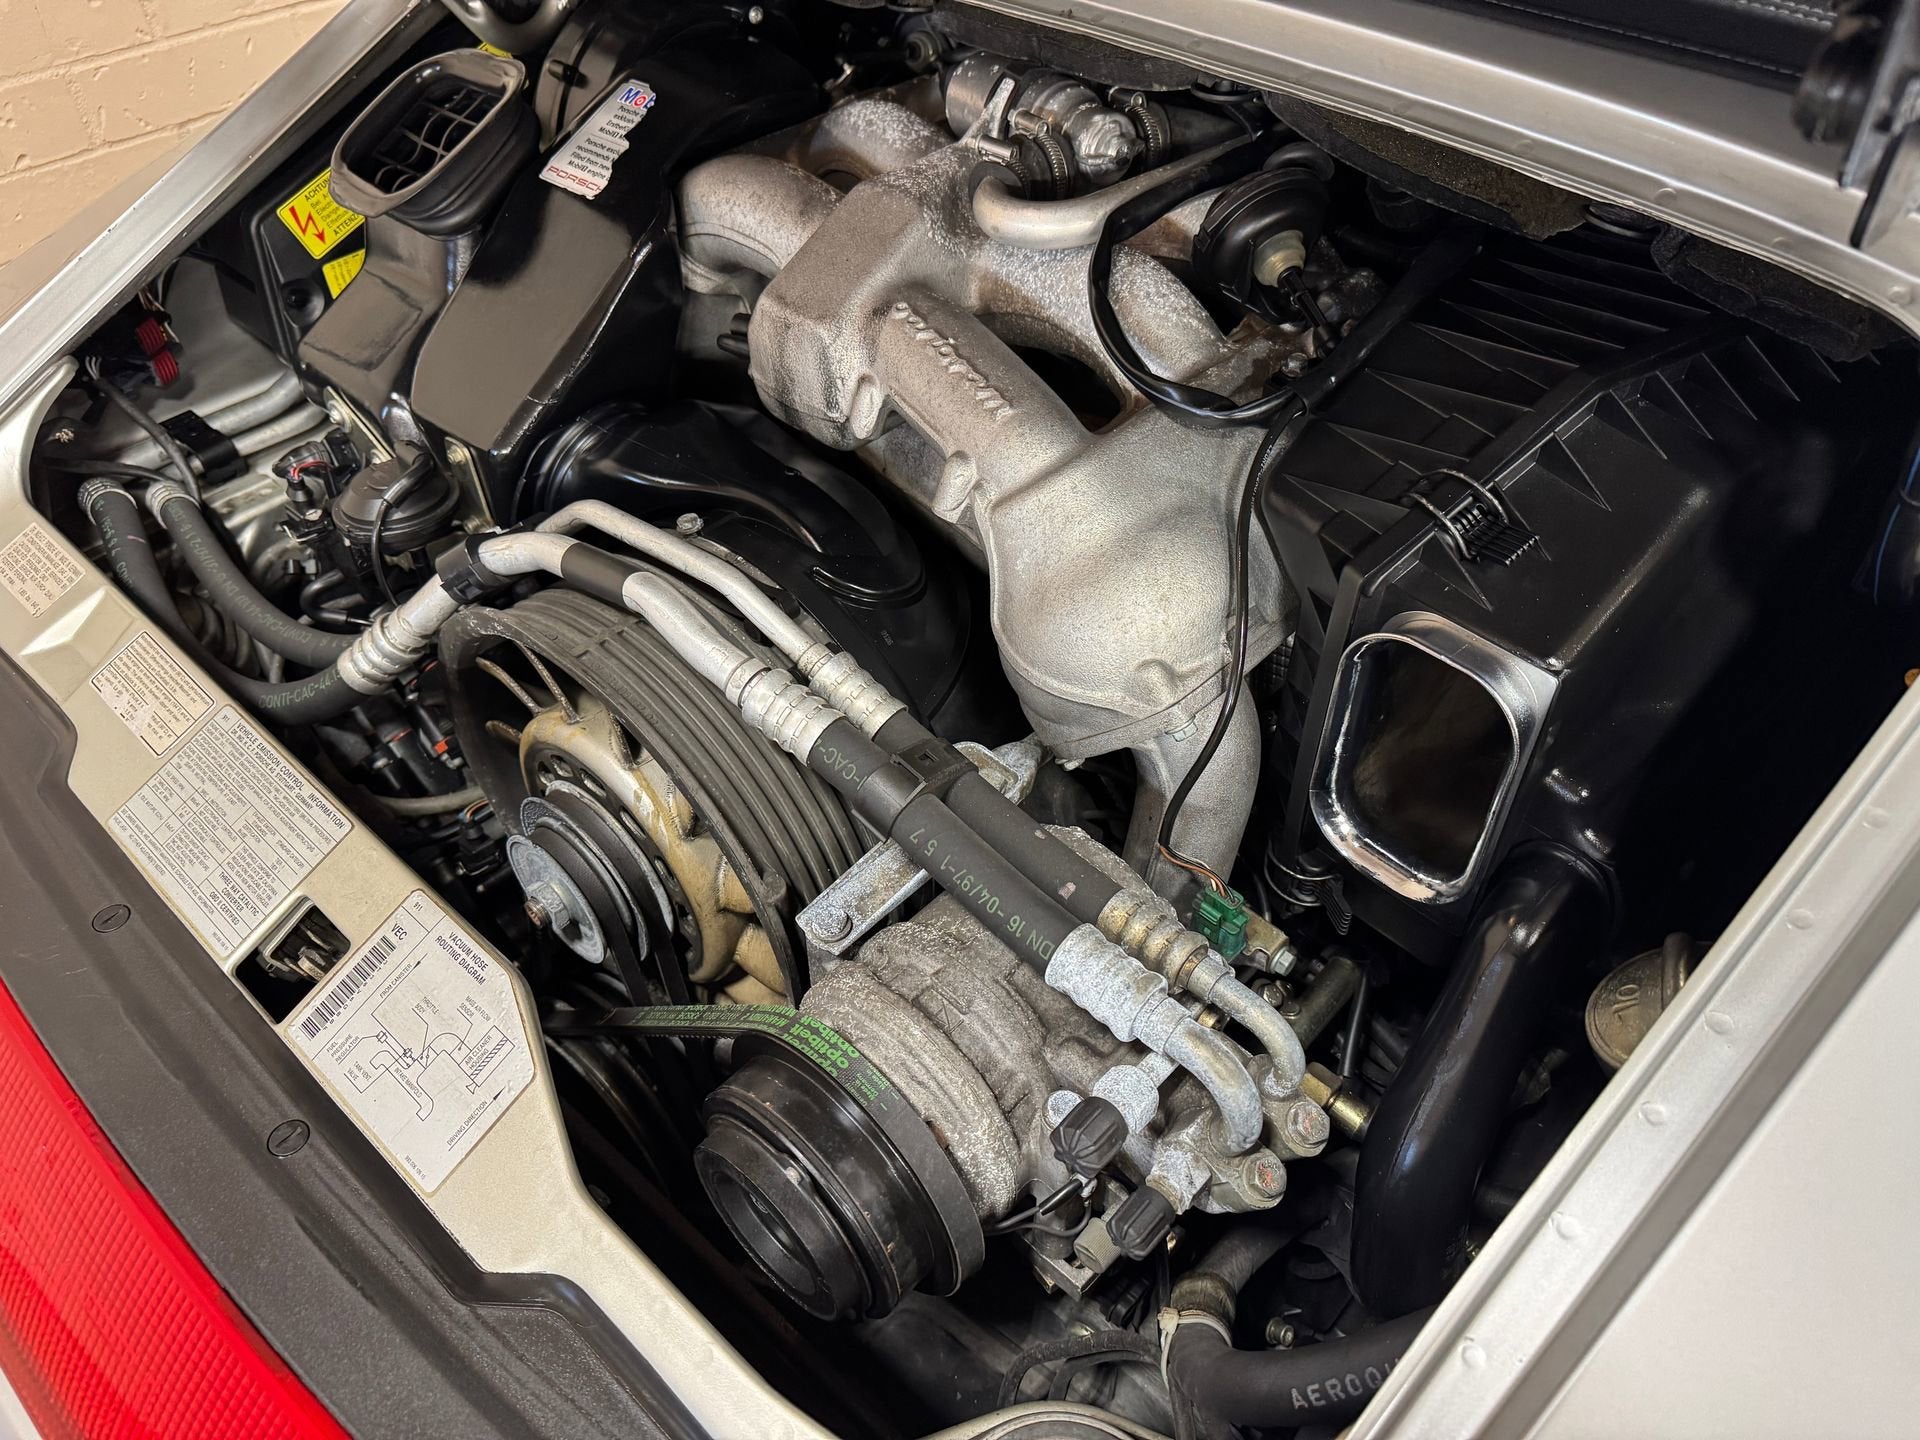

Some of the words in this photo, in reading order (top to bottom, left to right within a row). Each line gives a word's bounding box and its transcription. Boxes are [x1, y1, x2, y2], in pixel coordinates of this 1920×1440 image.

[235, 722, 258, 745] VEHICLE
[255, 742, 281, 767] EMISSION
[278, 764, 305, 791] CONTROL
[306, 792, 345, 830] INFORMATION
[274, 771, 296, 793] STUTTGART
[294, 791, 314, 811] GERMANY
[910, 828, 926, 843] 7
[923, 839, 938, 855] 5
[219, 902, 241, 925] CERTIFIED
[220, 886, 245, 912] CONVERTER
[237, 892, 260, 916] CATALYTIC
[412, 900, 423, 912] 911
[389, 922, 408, 941] VEC
[1007, 915, 1026, 940] 16
[434, 934, 461, 962] ROUTING
[457, 957, 485, 986] DIAGRAM
[447, 931, 473, 957] VACUUM
[468, 952, 488, 972] HOSE
[1026, 932, 1057, 961] DN
[379, 983, 393, 999] FROM
[390, 962, 412, 986] CANISTER
[334, 1034, 360, 1063] REGULATOR
[463, 1053, 474, 1066] AIR
[471, 1033, 492, 1057] CLEANER
[790, 1021, 849, 1069] optibelt
[801, 1014, 860, 1059] optibelt
[468, 1047, 489, 1071] HOUSING
[404, 1077, 423, 1099] MANIFOLD
[446, 1124, 465, 1146] DRIVING
[462, 1099, 488, 1127] DIRECTION
